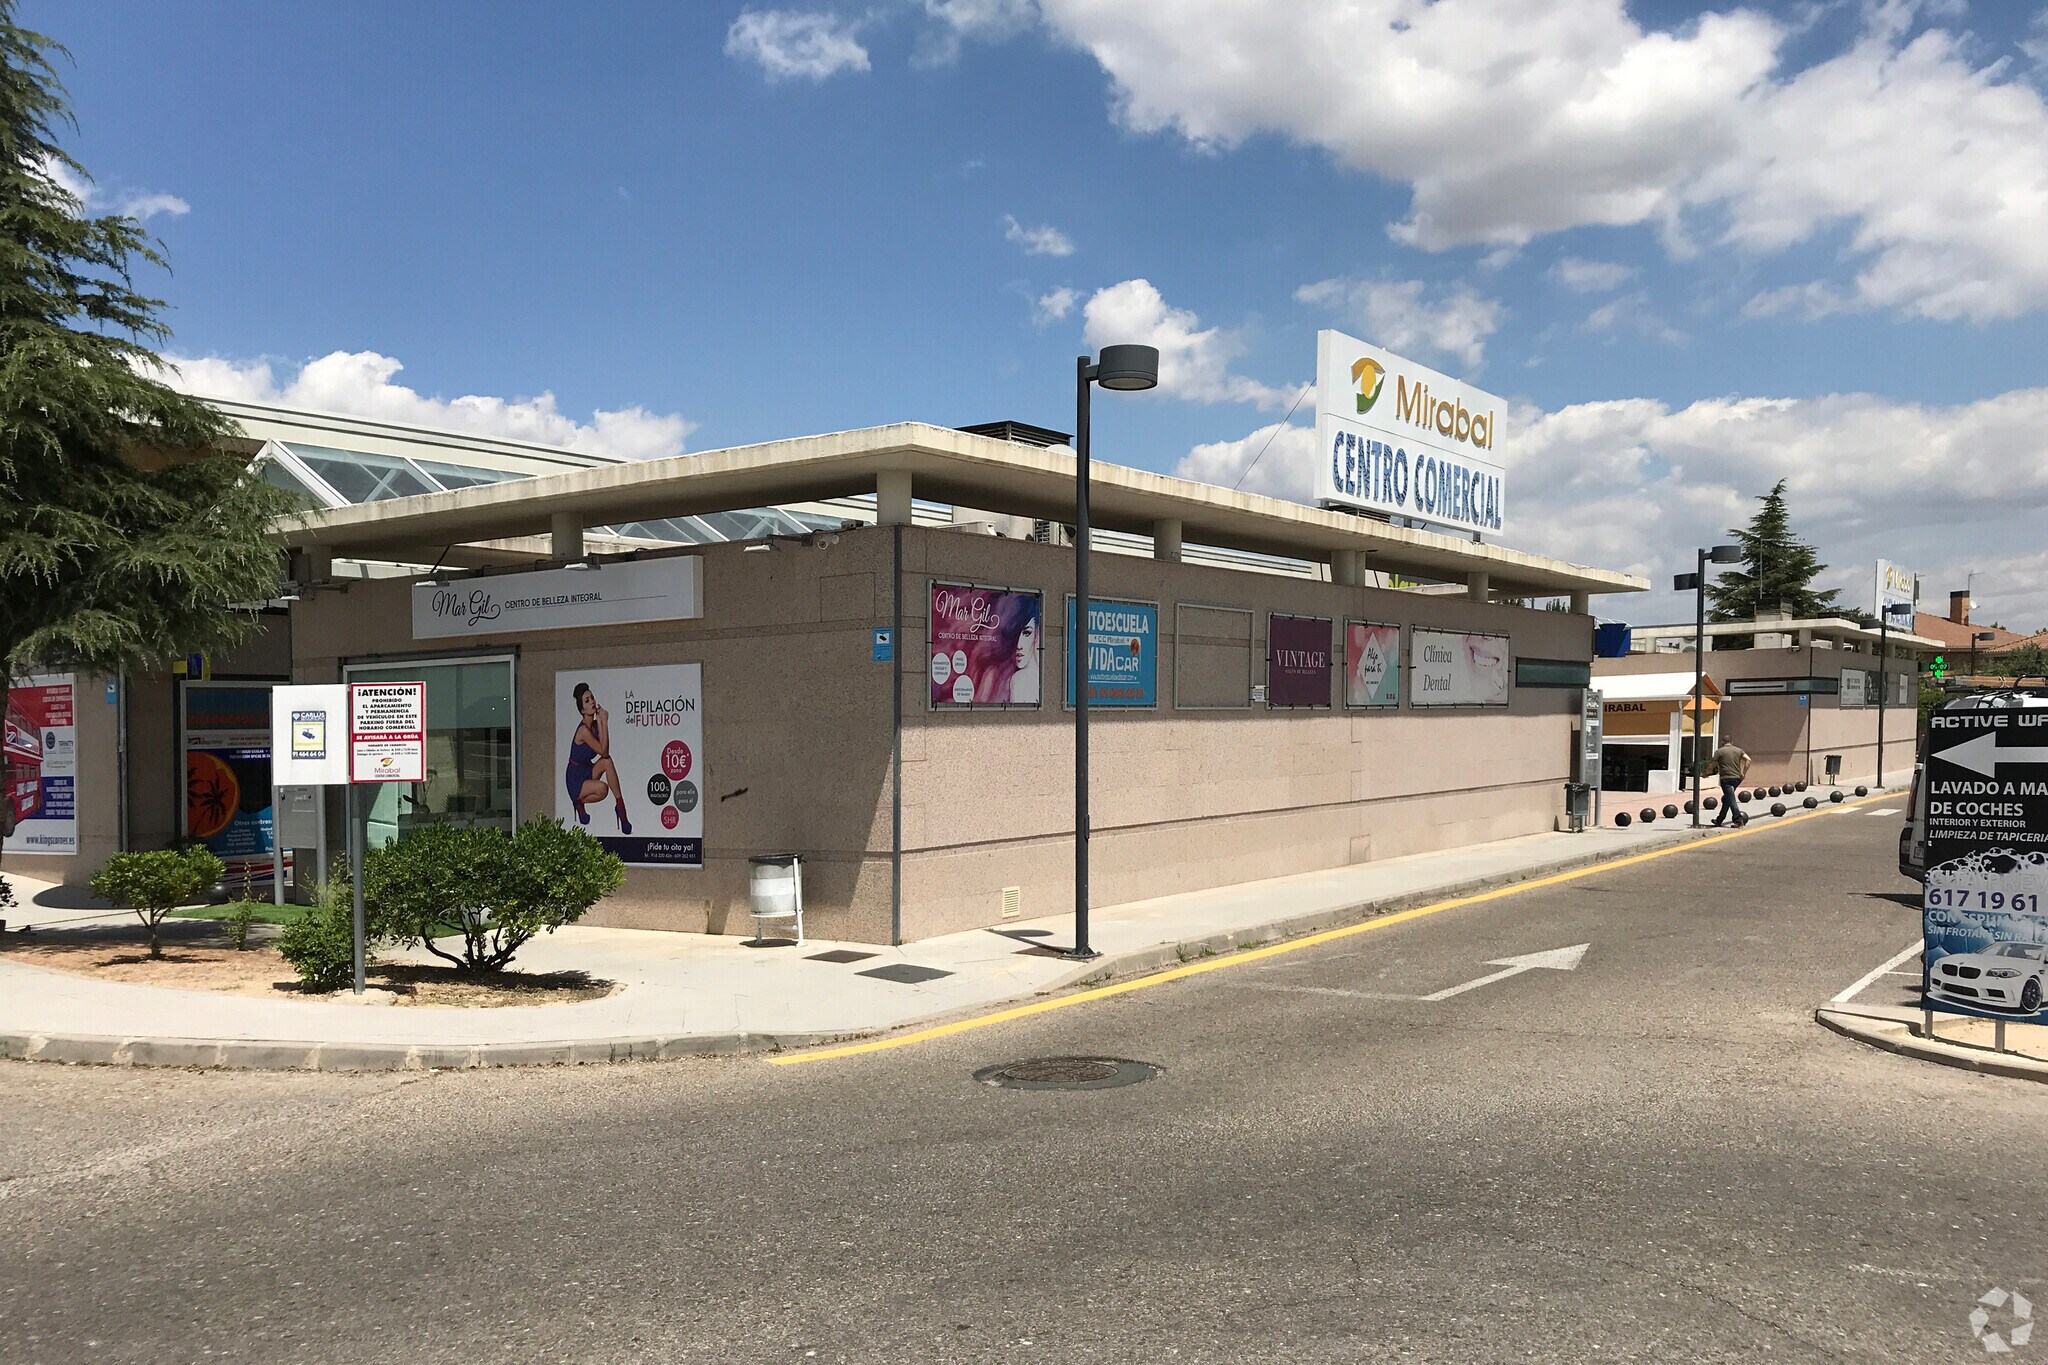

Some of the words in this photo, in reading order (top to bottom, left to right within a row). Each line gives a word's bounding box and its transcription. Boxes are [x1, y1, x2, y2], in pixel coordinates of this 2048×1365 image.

[1395, 374, 1495, 451] Mirabal
[1332, 430, 1409, 507] CENTRO
[1414, 453, 1502, 530] COMERCIAL
[431, 590, 467, 618] Mar
[467, 589, 501, 627] Gil
[504, 599, 531, 609] CENTRO
[532, 597, 541, 607] DE
[542, 595, 570, 606] BELLEZA
[570, 592, 602, 603] INTEGRAL
[935, 590, 969, 621] Mar
[969, 597, 1000, 633] Gil
[1075, 611, 1149, 633] TOESCUELA
[938, 632, 955, 640] CENTRO
[1276, 649, 1325, 668] VINTAGE
[1423, 644, 1452, 663] Clínica
[1423, 673, 1452, 691] Dental
[358, 686, 417, 696] ¡ATENCIÓN!
[625, 690, 634, 699] LA
[626, 694, 695, 714] DEPILACIÓN
[1604, 703, 1647, 712] IRABAL
[1931, 715, 2009, 729] ACTIVE
[1931, 781, 2000, 795] LAVADO
[2003, 782, 2015, 795] A
[1930, 801, 1952, 815] DE
[1956, 802, 2024, 817] COCHES
[1929, 817, 1971, 827] INTERIOR
[1972, 819, 1979, 827] Y
[1980, 819, 2026, 828] EXTERIOR
[1929, 829, 1977, 840] LIMPIEZA
[1979, 831, 1994, 841] DE
[663, 843, 670, 851] tu
[1929, 888, 1970, 907] 617
[1978, 891, 2005, 910] 19
[2011, 893, 2038, 912] 61
[1928, 925, 1944, 935] SIN
[1994, 930, 2012, 941] SIN
